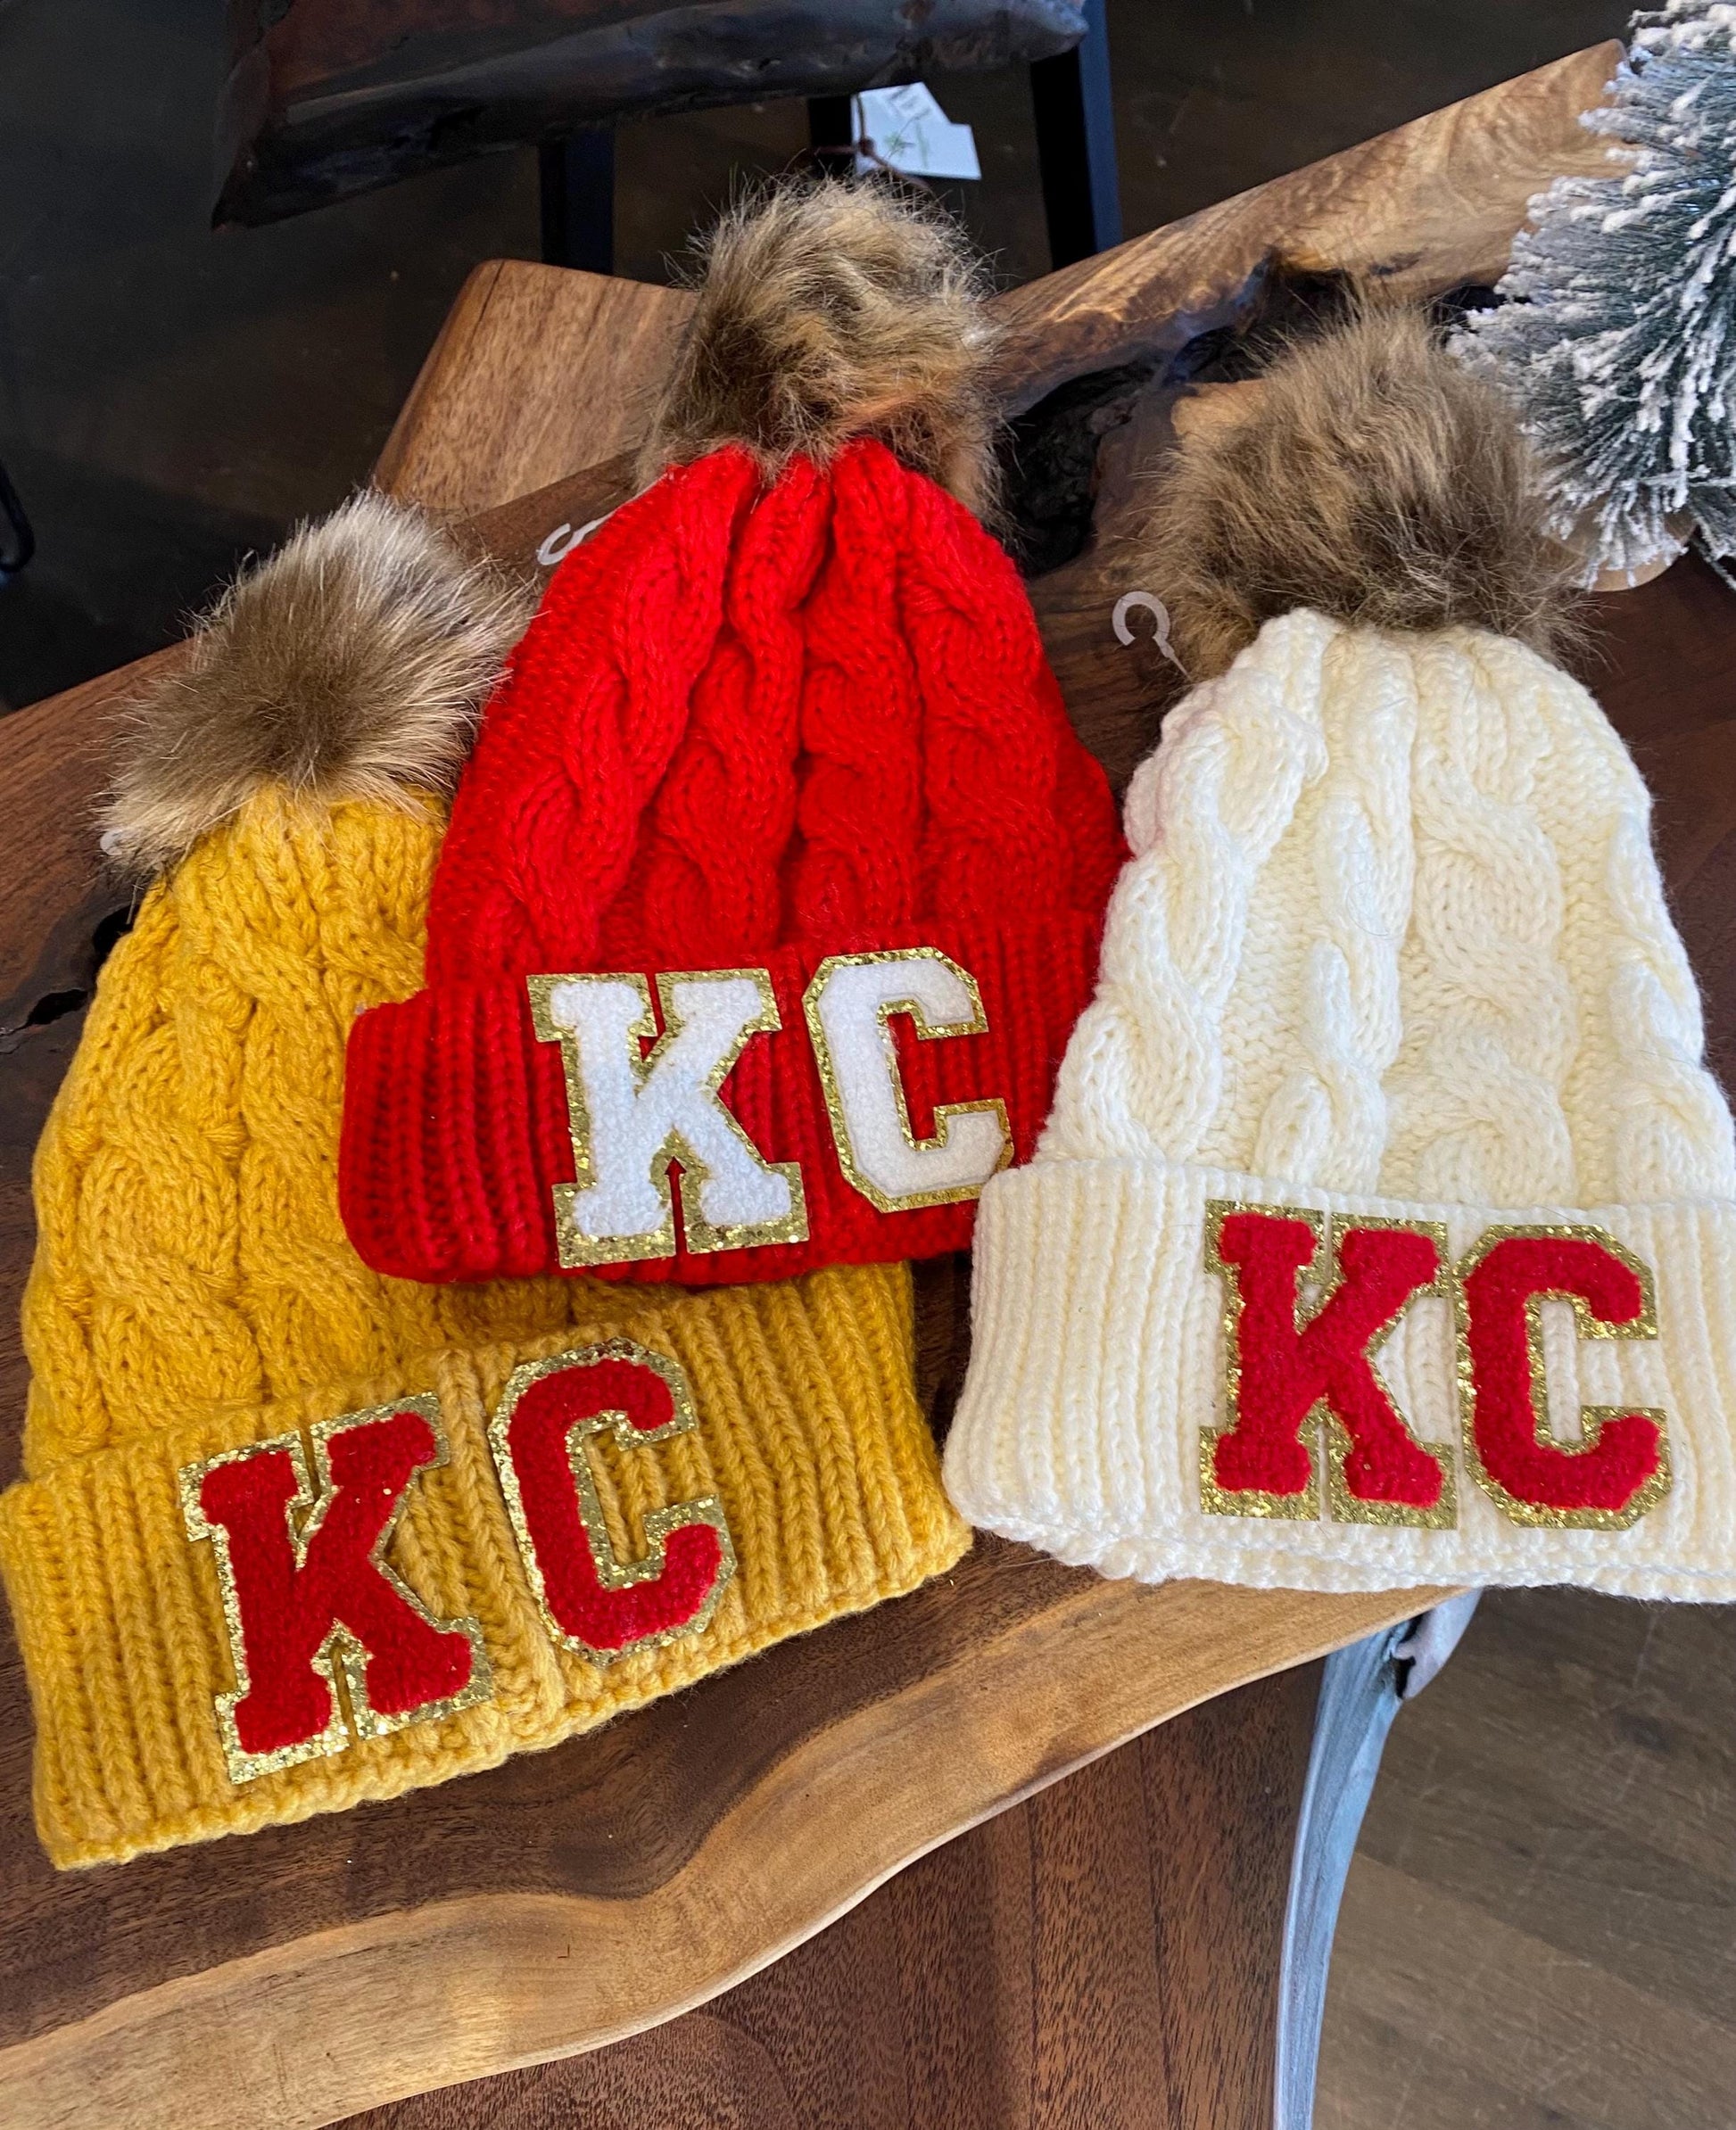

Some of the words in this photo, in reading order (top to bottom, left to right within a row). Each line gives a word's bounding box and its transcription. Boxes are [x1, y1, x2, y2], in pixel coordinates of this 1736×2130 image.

[526, 947, 1014, 1268] KC
[1200, 1200, 1673, 1529] KC
[178, 1337, 738, 1784] KC
